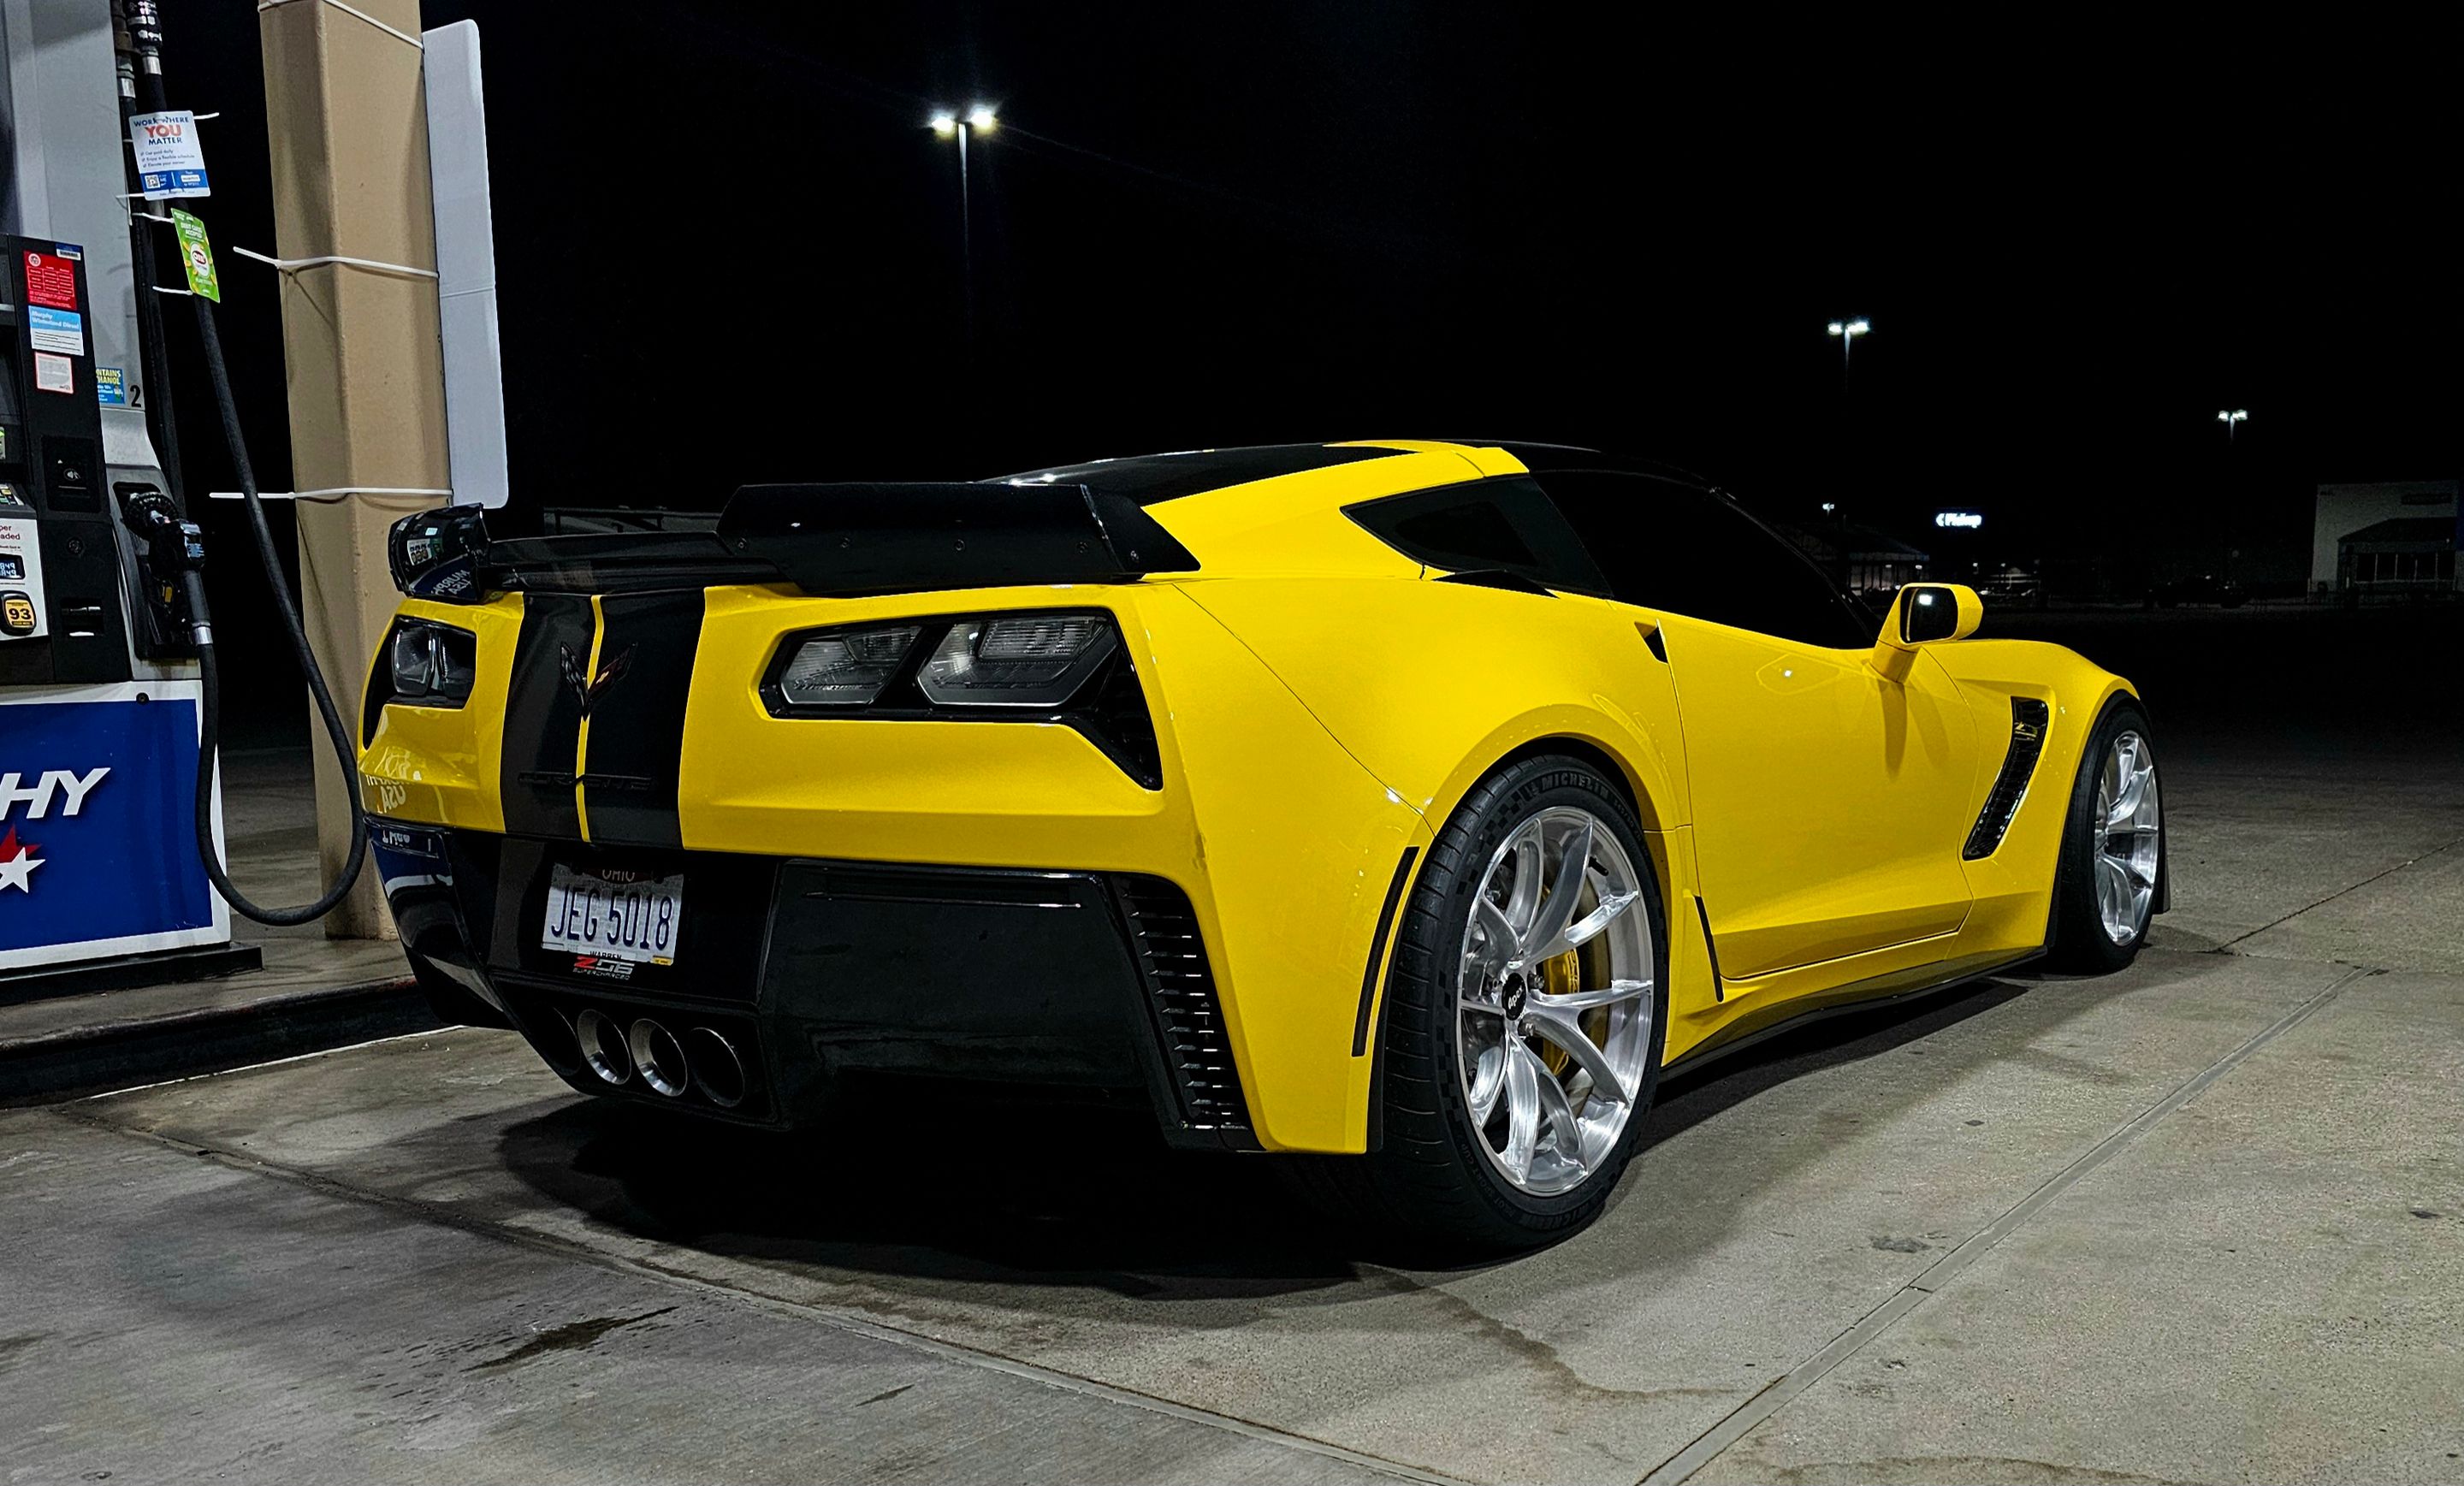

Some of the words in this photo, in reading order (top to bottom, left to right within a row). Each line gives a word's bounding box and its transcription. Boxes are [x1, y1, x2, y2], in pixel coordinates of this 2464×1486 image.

[133, 117, 157, 127] WORK
[144, 124, 182, 139] YOU
[148, 137, 183, 146] MATTER
[130, 385, 141, 407] 2
[9, 608, 32, 620] 93
[0, 767, 111, 821] HY
[1541, 771, 1609, 802] MICHELIN
[551, 885, 601, 942] JEG
[607, 890, 673, 951] 5018
